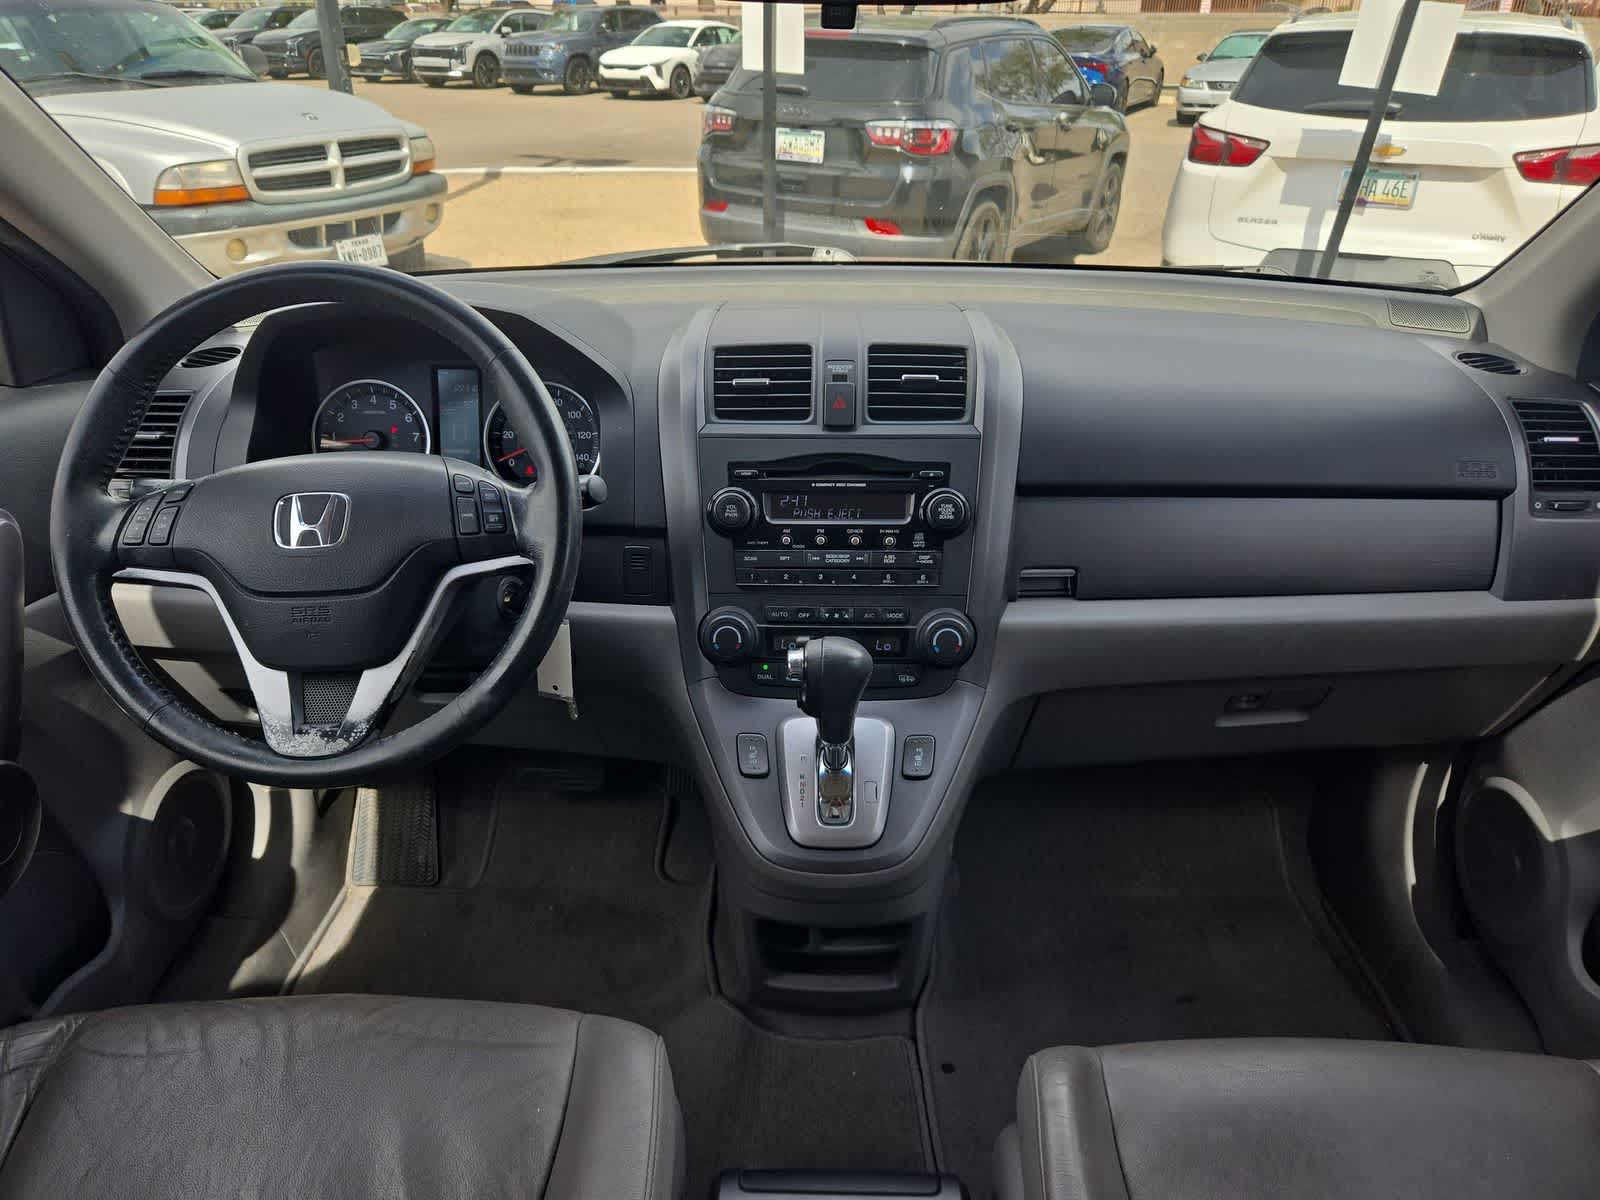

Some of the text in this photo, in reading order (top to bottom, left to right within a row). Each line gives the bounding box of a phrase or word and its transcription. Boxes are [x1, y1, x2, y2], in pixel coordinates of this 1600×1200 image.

[1382, 180, 1408, 199] 46E
[351, 400, 358, 409] 3
[369, 395, 377, 405] 4
[389, 400, 397, 410] 5
[337, 413, 345, 422] 2
[405, 413, 413, 423] 6
[567, 411, 582, 419] 100
[412, 432, 420, 442] 7
[503, 431, 514, 440] 20
[577, 431, 592, 439] 120
[508, 458, 516, 466] 0
[575, 453, 590, 462] 140
